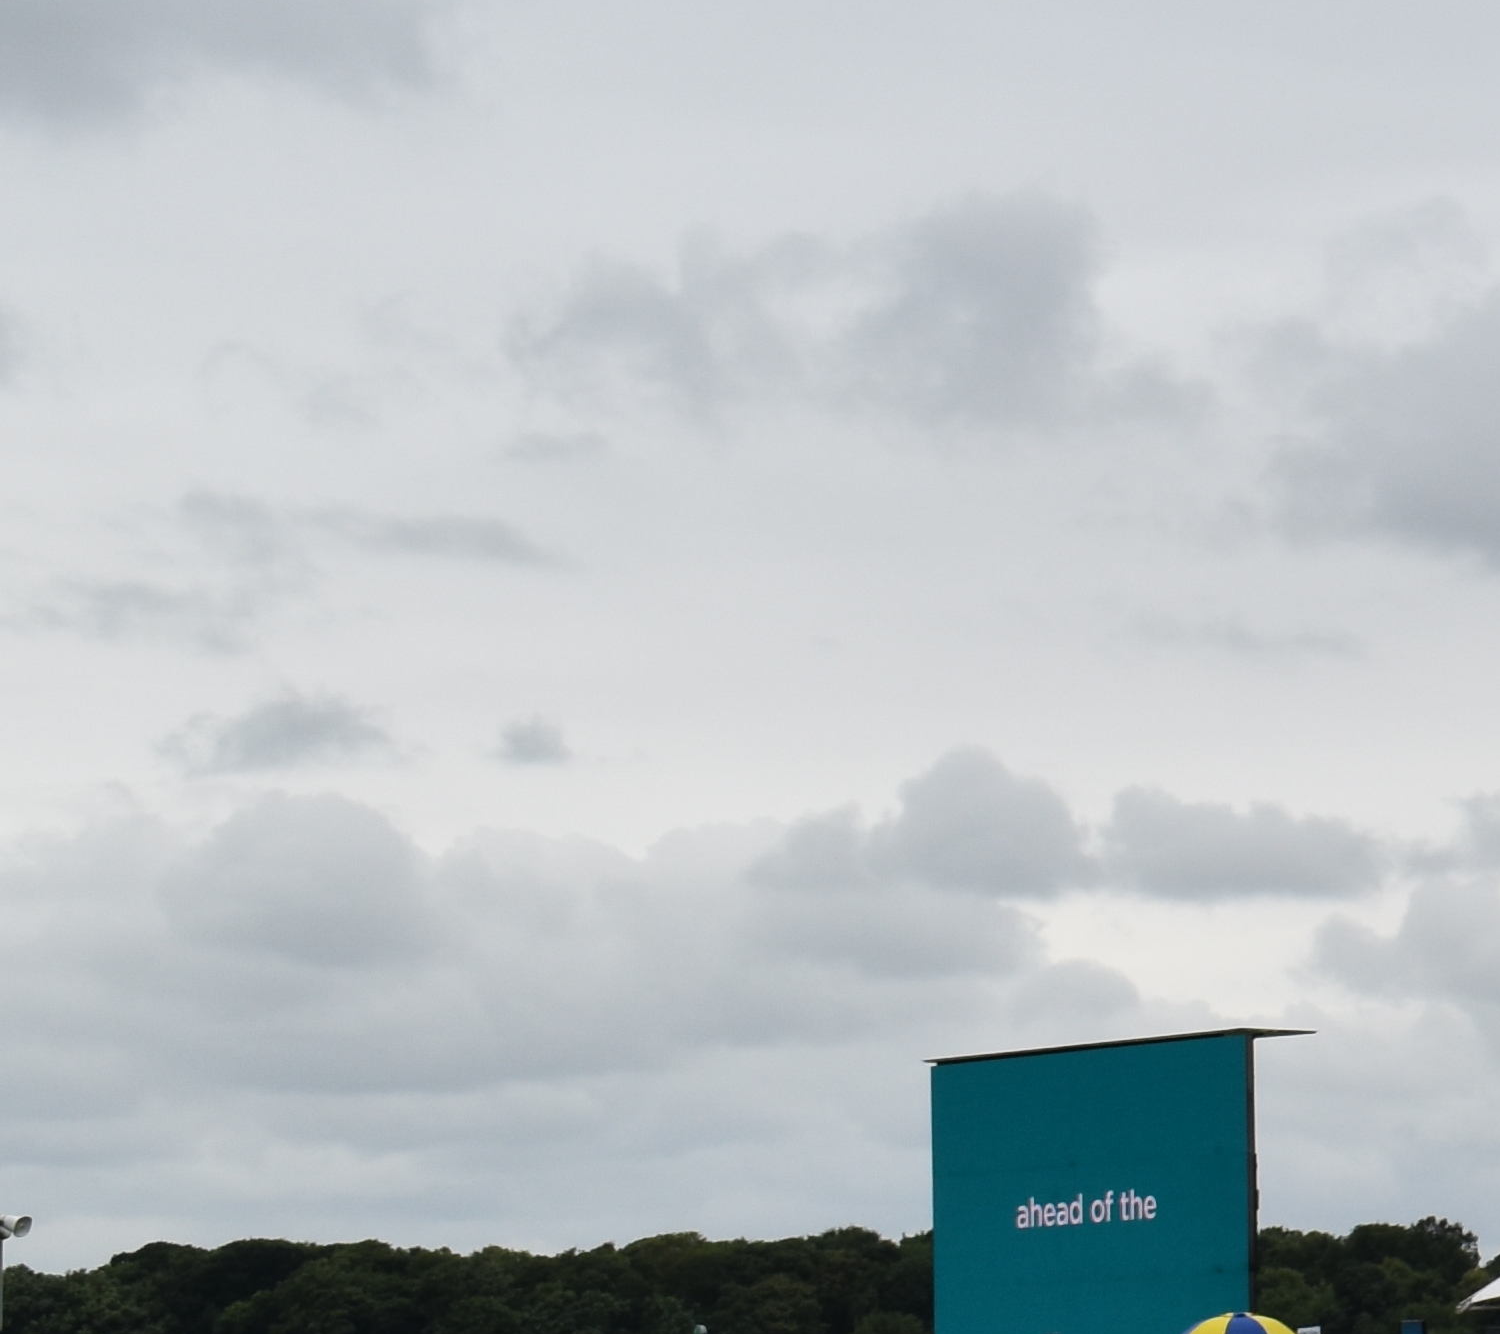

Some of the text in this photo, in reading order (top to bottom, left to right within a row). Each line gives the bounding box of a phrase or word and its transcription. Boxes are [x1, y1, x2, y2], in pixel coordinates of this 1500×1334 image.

[1017, 1189, 1157, 1229] ahead of the
